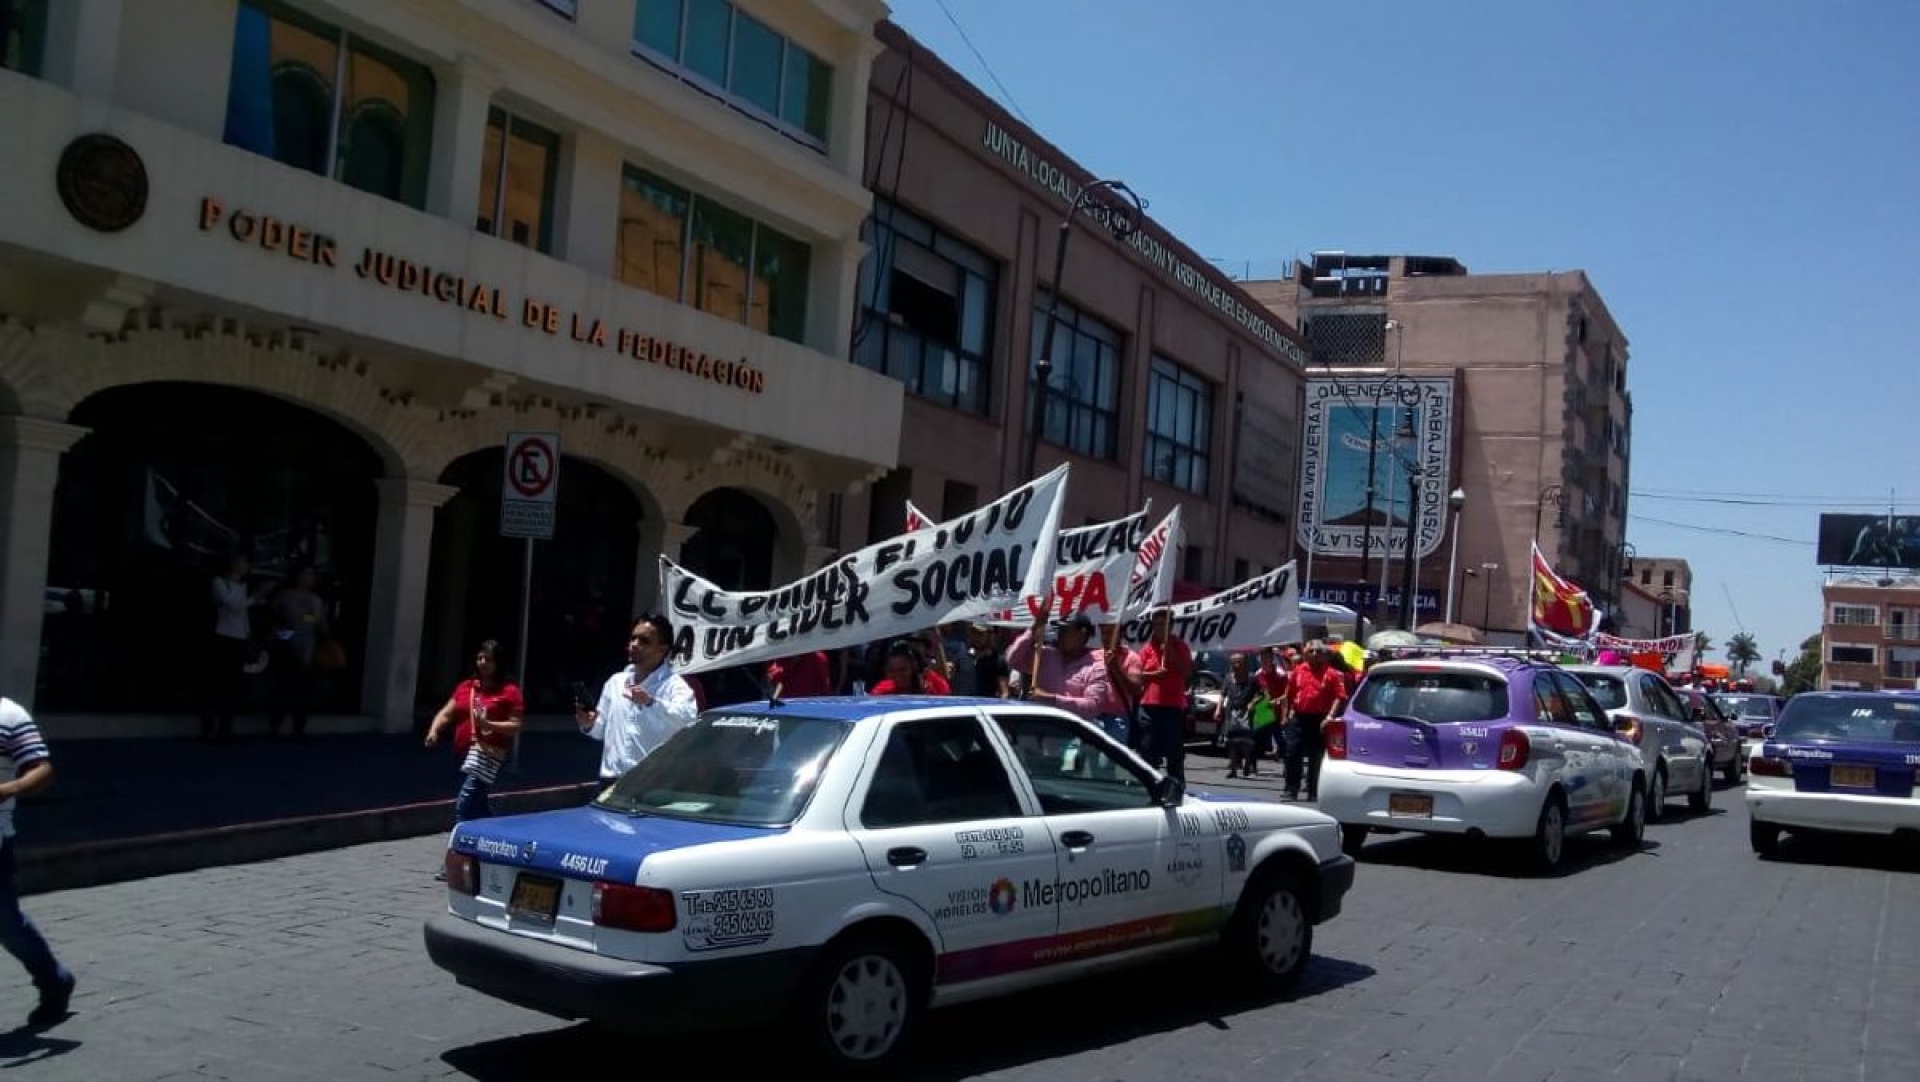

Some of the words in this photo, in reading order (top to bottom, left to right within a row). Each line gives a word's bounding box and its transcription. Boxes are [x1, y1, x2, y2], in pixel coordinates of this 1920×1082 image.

[983, 120, 1029, 175] JUNTA
[1031, 155, 1073, 203] LOCAL
[198, 195, 337, 268] PODER
[354, 246, 508, 319] JUDICIAL
[522, 297, 561, 334] DE
[570, 312, 607, 347] LA
[617, 326, 766, 394] FEDERACIÓN
[669, 624, 695, 664] A
[704, 626, 755, 661] UN
[892, 543, 1024, 616] SOCIAL
[1123, 612, 1238, 644] COTIGO
[1023, 868, 1150, 908] Metropolitano
